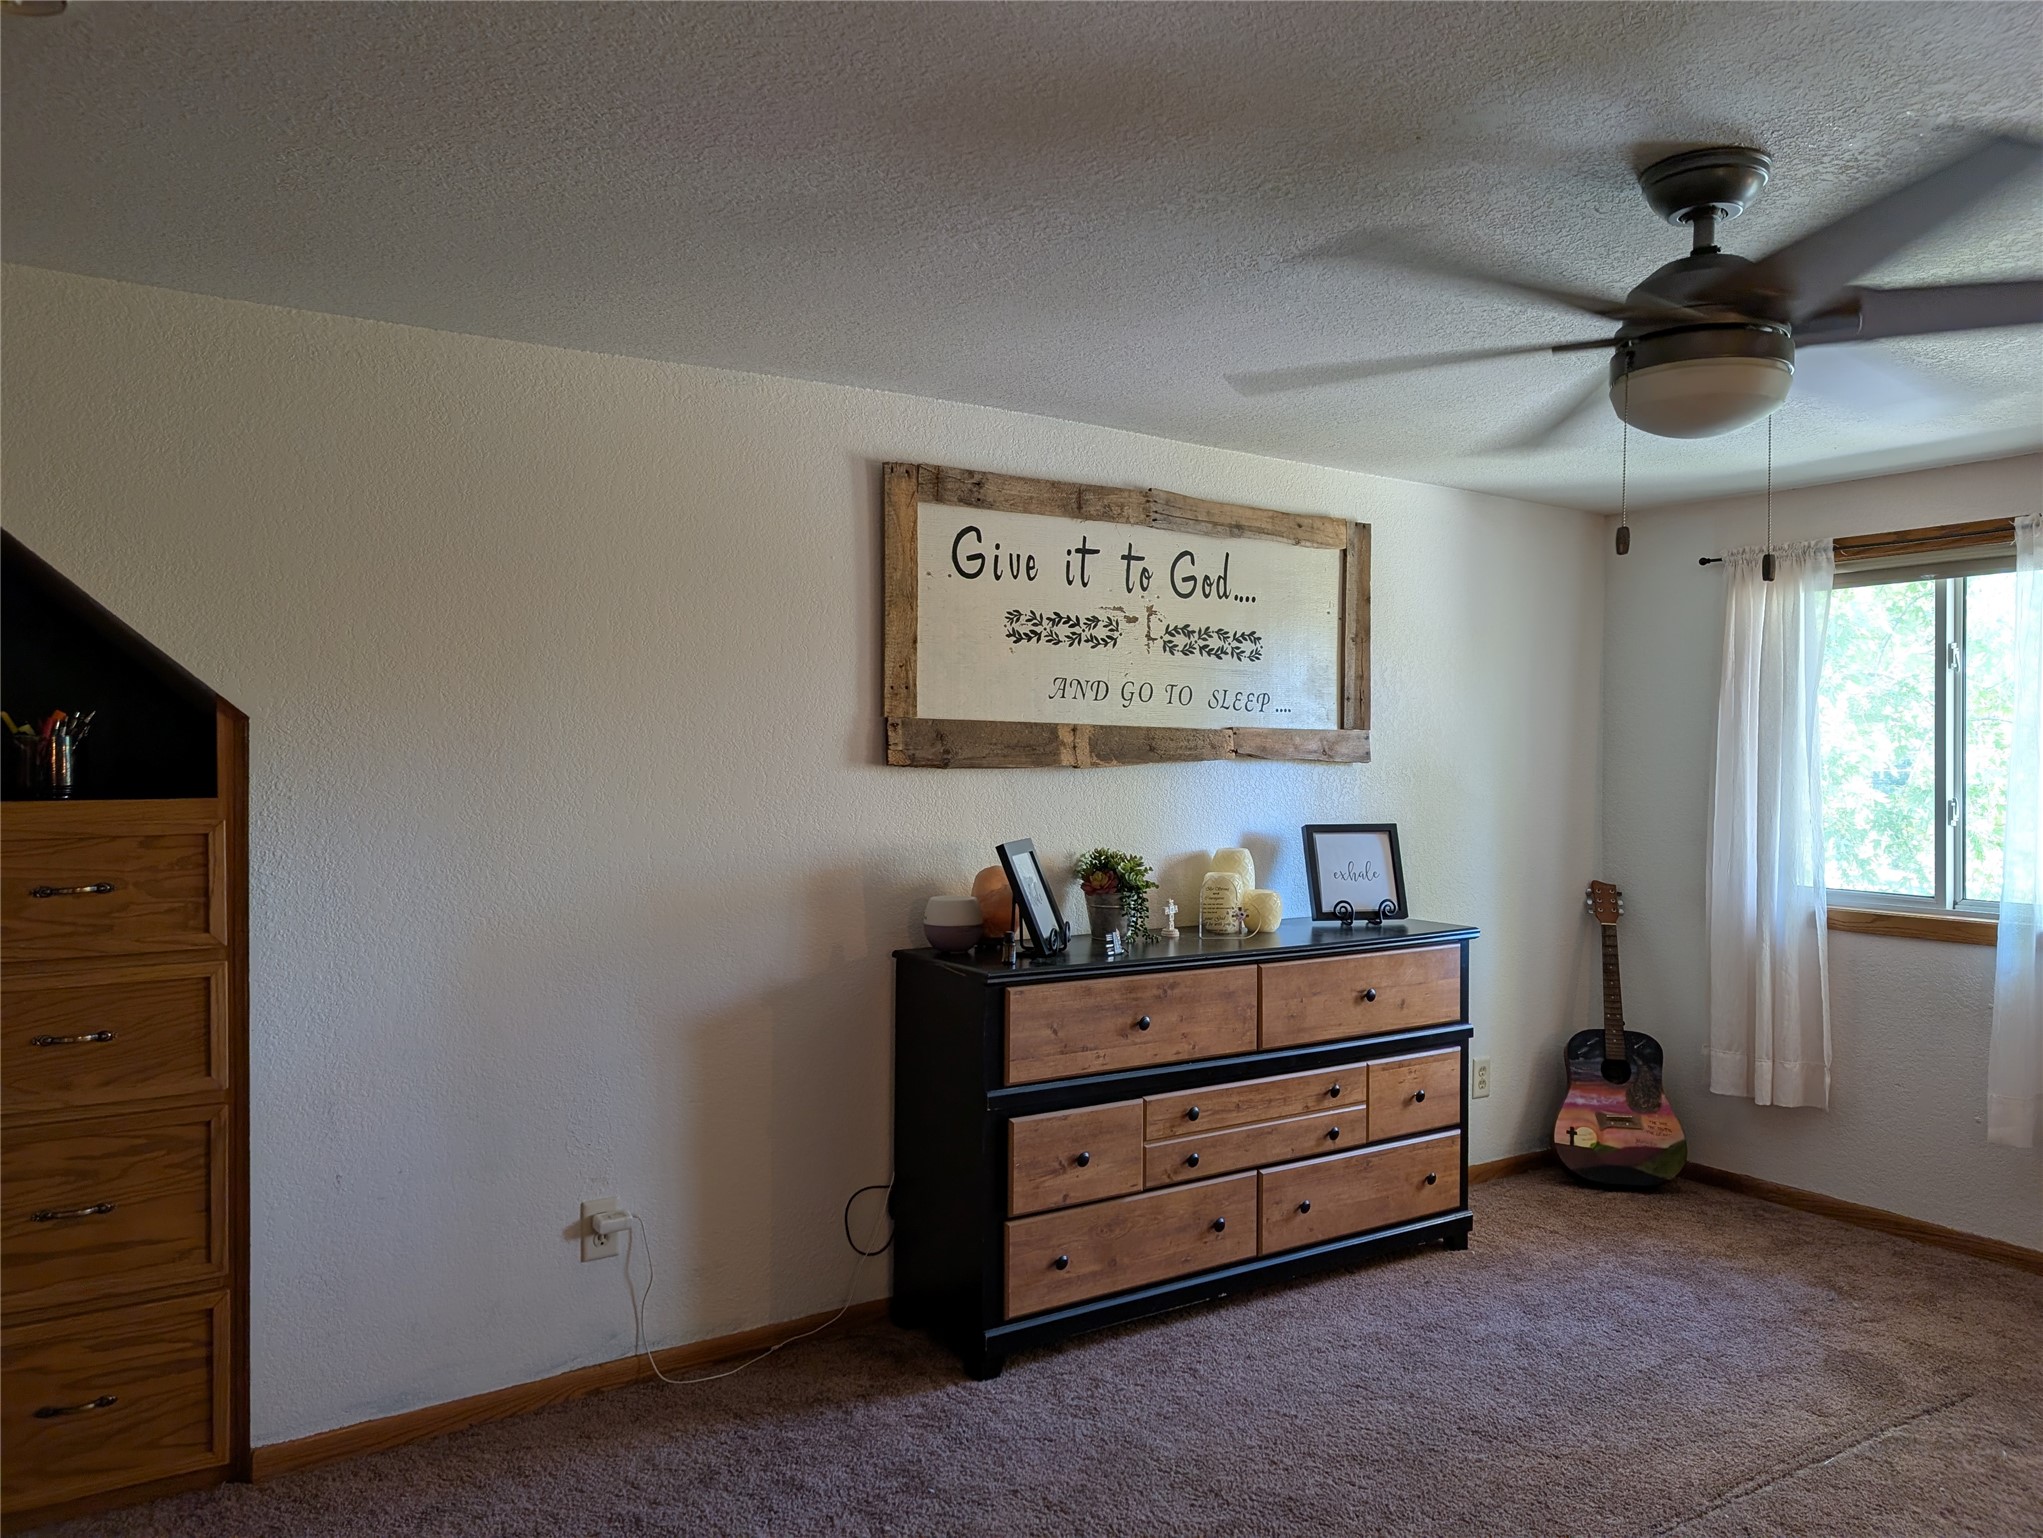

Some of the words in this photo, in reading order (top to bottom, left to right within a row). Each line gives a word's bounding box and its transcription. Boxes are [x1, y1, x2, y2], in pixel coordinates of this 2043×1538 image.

[952, 525, 1038, 581] Give
[1066, 535, 1101, 588] it
[1120, 542, 1153, 594] to
[1048, 677, 1109, 701] AND
[1120, 680, 1154, 708] GO
[1164, 684, 1193, 706] TO
[1333, 860, 1380, 882] exhale
